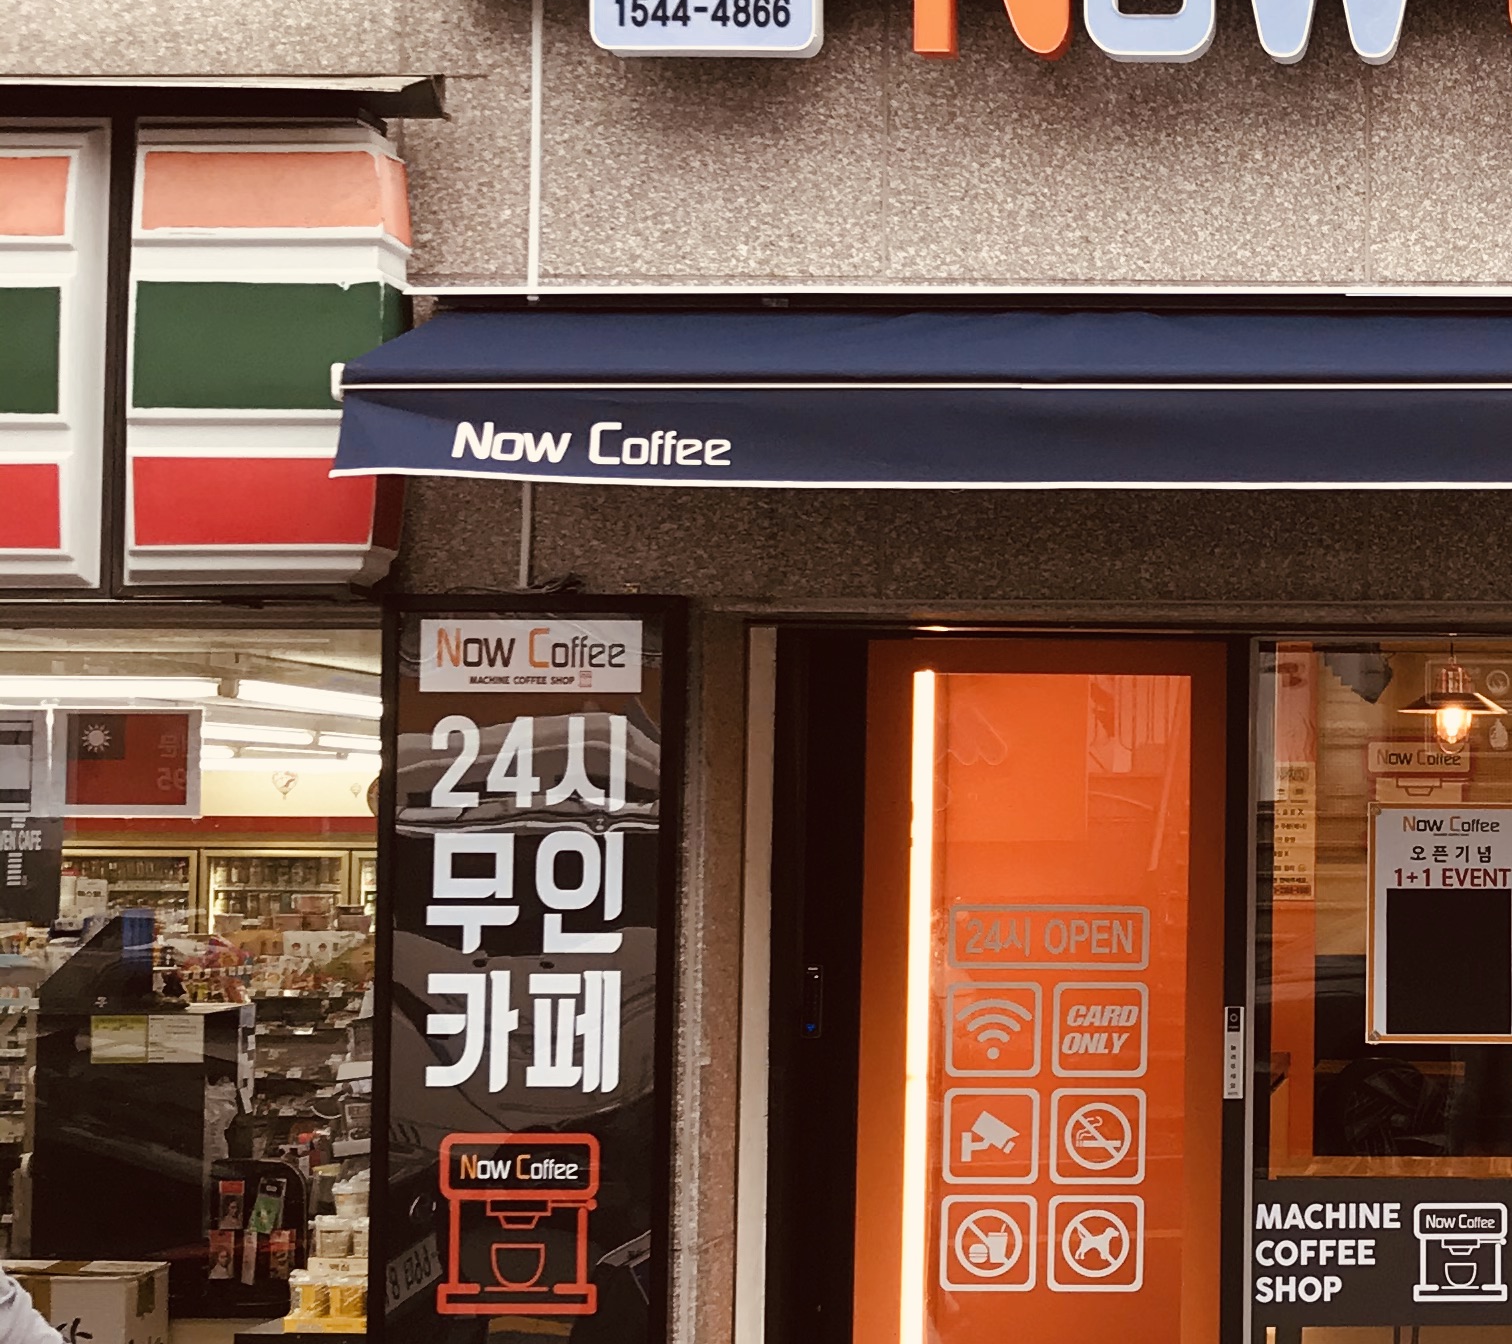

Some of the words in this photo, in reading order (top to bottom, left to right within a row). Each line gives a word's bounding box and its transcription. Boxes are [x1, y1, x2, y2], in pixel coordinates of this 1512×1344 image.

[588, 421, 732, 467] Coffee
[528, 626, 626, 669] Coffee
[469, 675, 510, 685] MACHINE
[513, 675, 547, 685] COFFEE
[550, 675, 575, 685] SHOP
[430, 713, 628, 813] 24시
[1449, 815, 1501, 833] Coffee
[426, 829, 624, 955] 무인
[1394, 868, 1431, 887] 1+1
[1441, 868, 1512, 888] EVENT
[965, 918, 1031, 957] 24시
[1044, 918, 1134, 955] OPEN
[1066, 1004, 1139, 1027] CARD
[425, 968, 622, 1094] 카페
[1061, 1032, 1130, 1054] ONLY
[516, 1154, 579, 1181] Coffee
[1254, 1202, 1401, 1230] MACHINE
[1459, 1214, 1497, 1230] Coffee
[1254, 1239, 1376, 1267] COFFEE
[1254, 1275, 1343, 1304] SHOP
